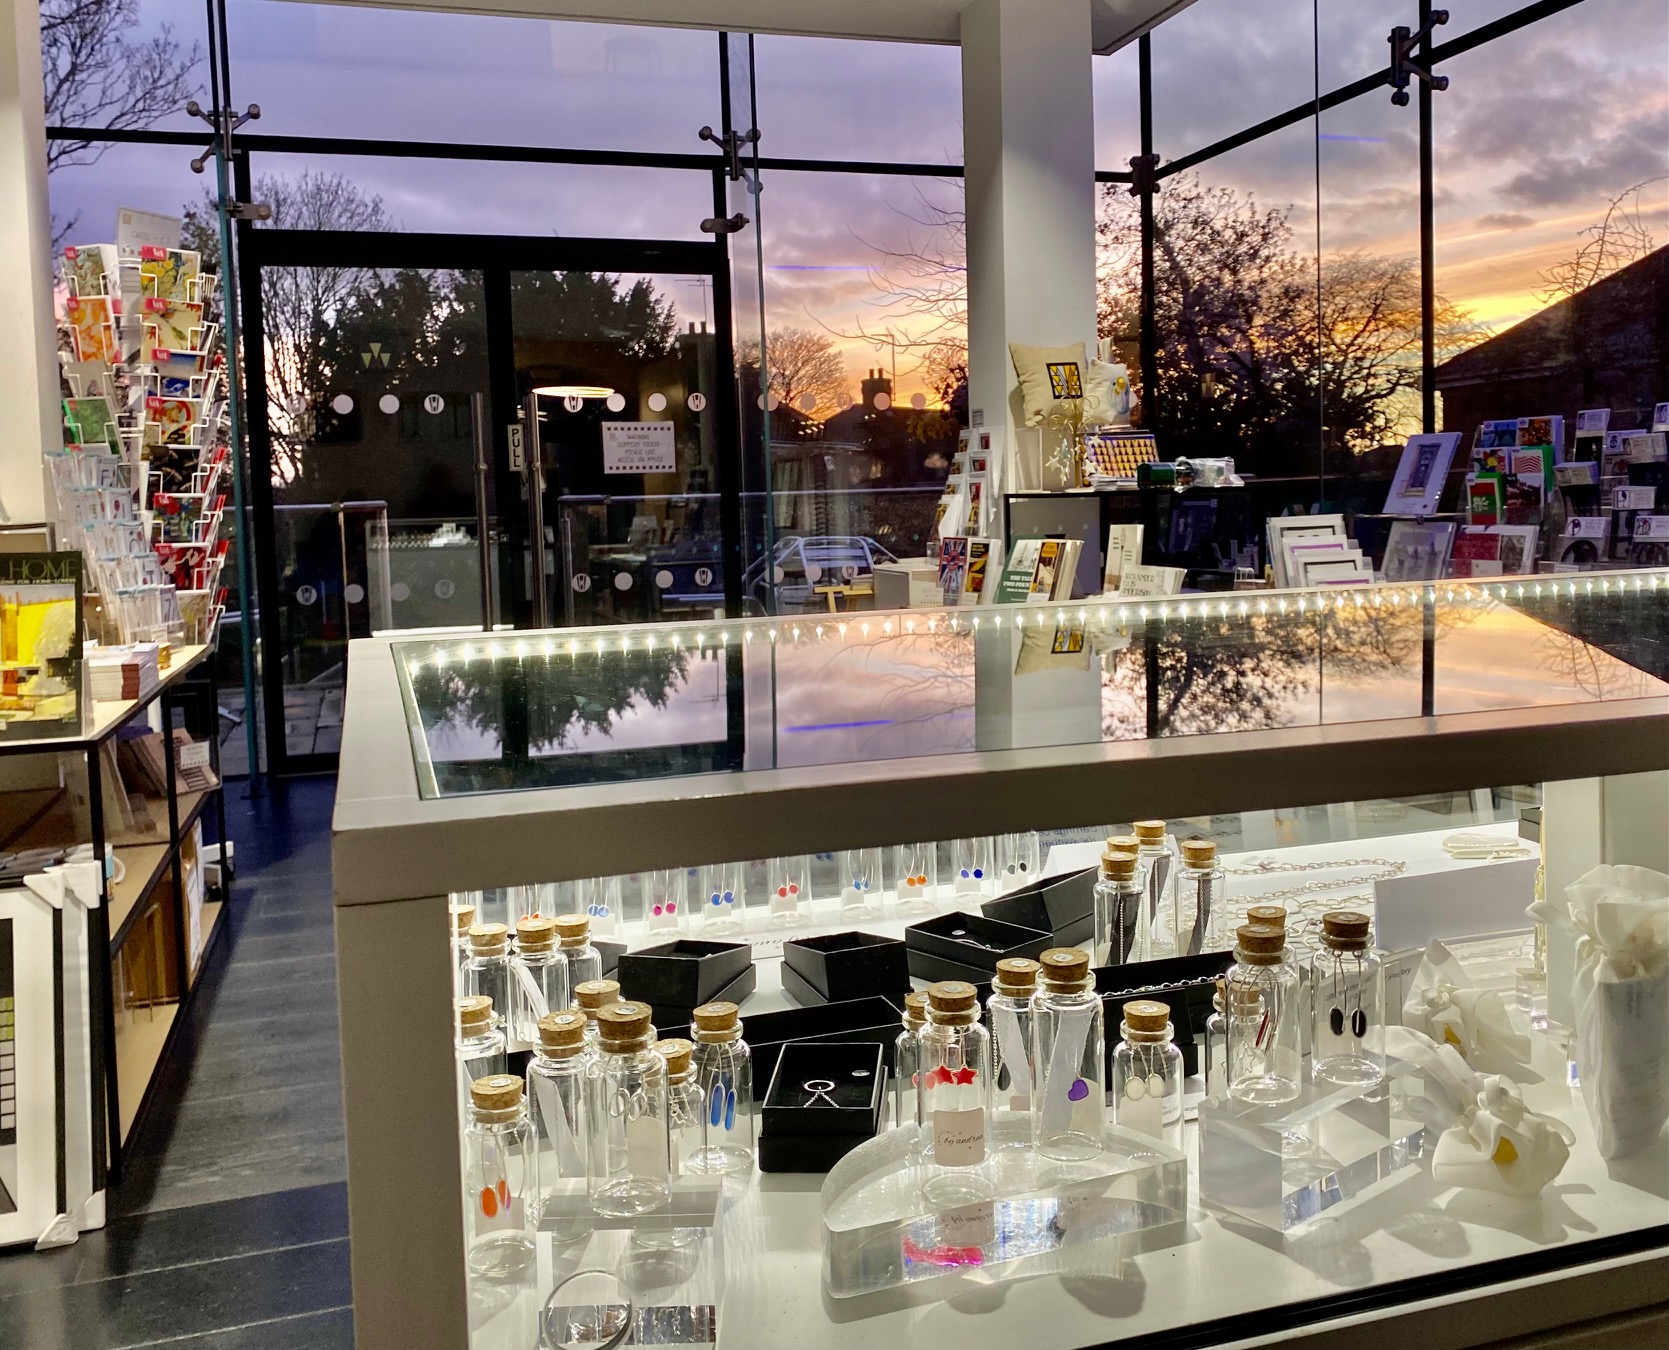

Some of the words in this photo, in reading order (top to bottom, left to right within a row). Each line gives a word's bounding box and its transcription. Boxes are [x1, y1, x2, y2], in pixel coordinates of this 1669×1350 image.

[511, 428, 521, 468] PULL
[9, 559, 77, 579] HOME
[943, 1136, 955, 1147] by
